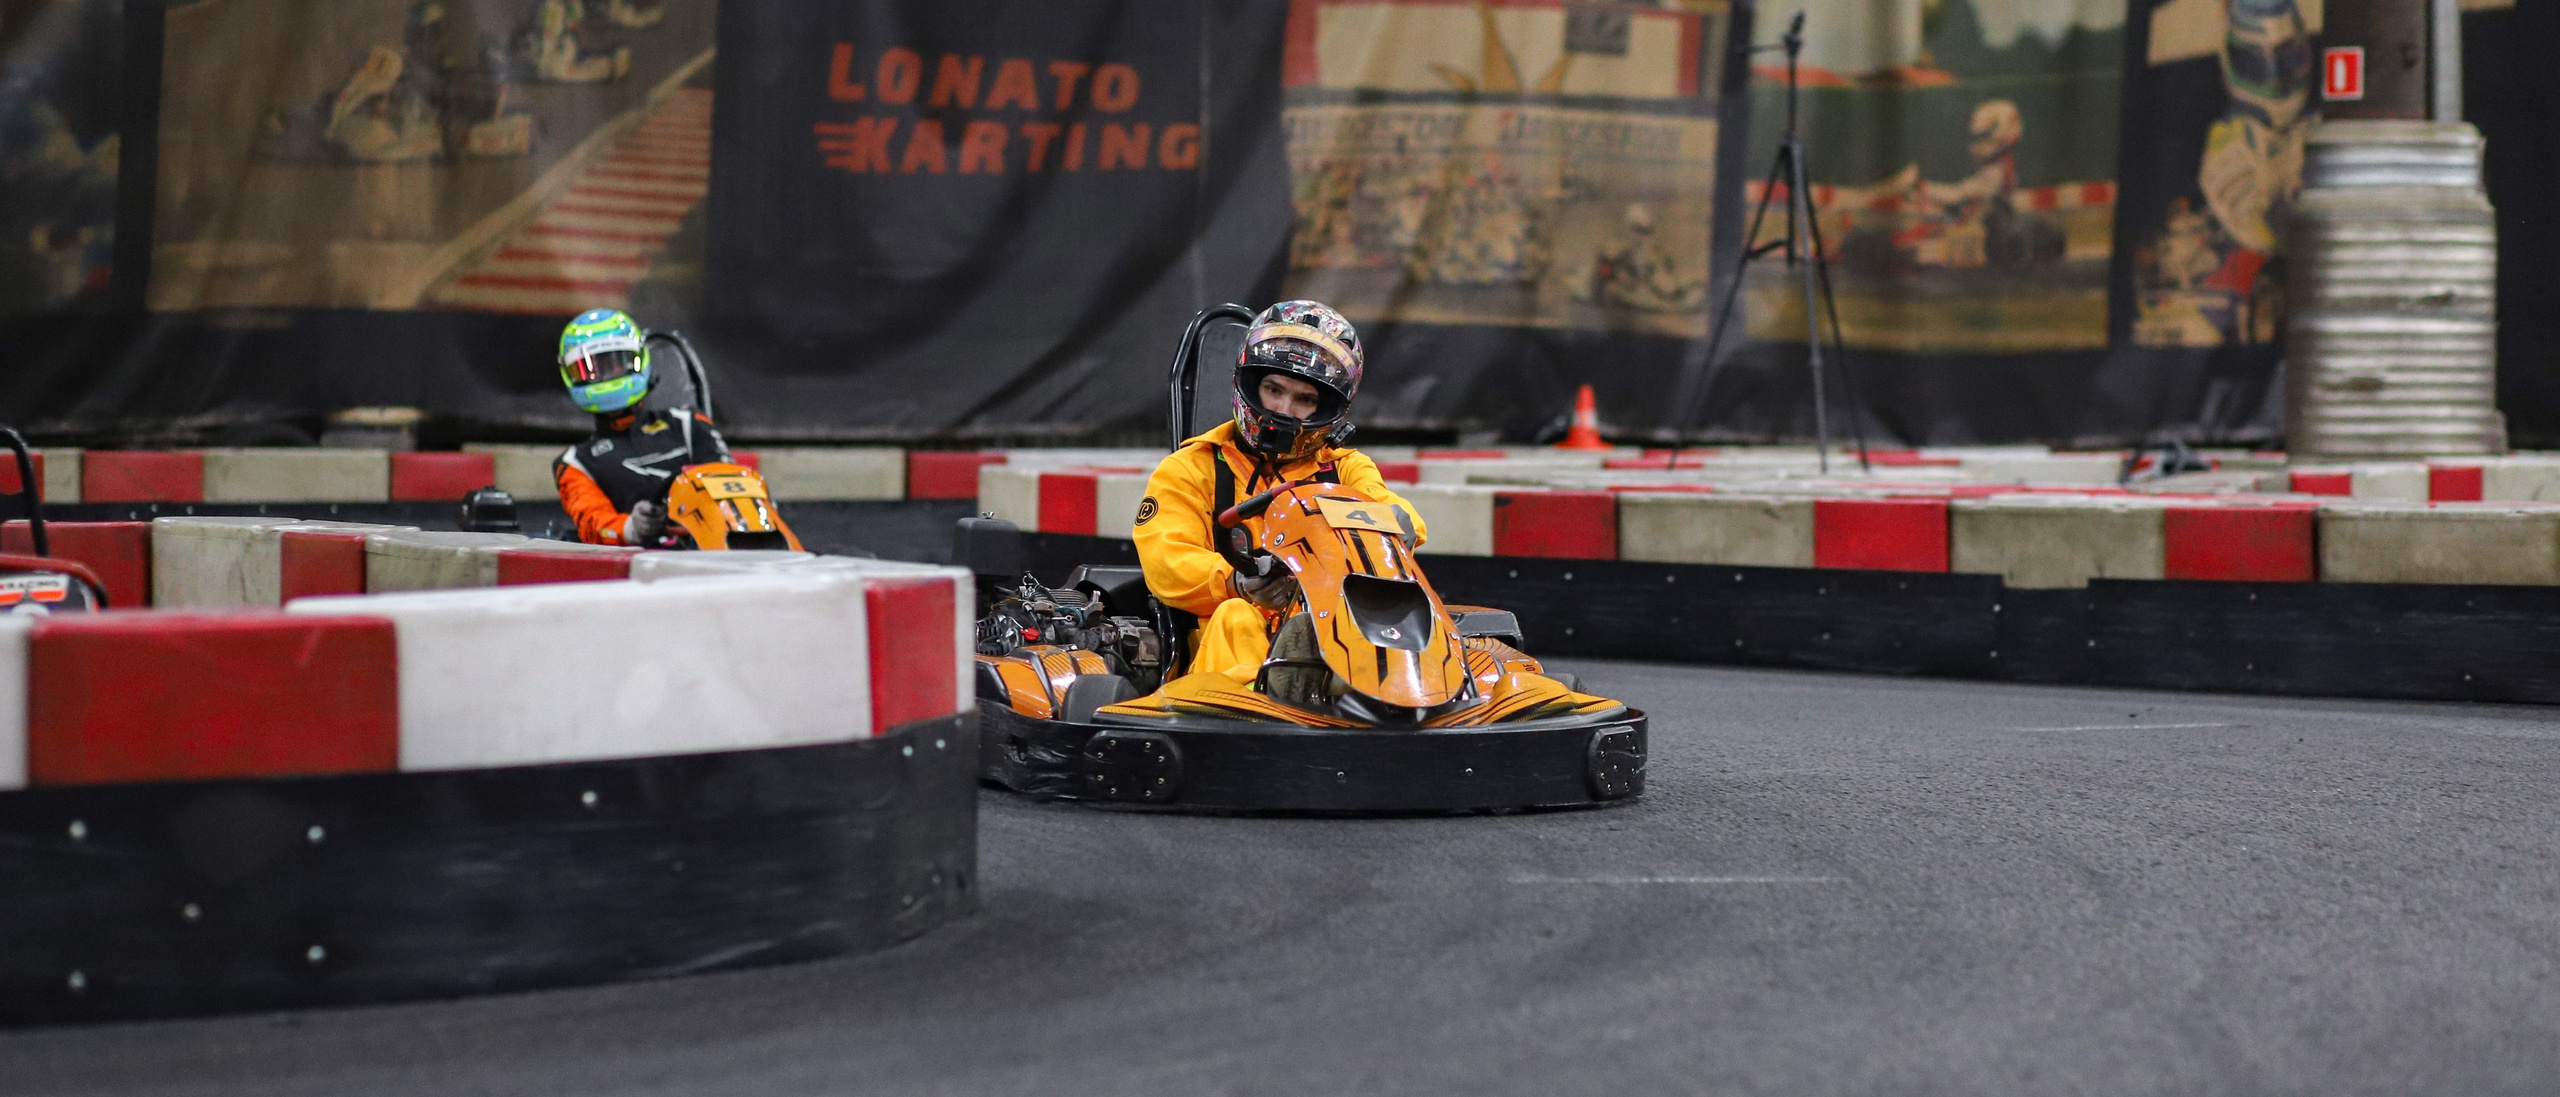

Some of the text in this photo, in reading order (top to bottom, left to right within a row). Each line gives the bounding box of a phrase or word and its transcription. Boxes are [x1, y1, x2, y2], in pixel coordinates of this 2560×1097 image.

[827, 42, 1140, 112] LONATO
[832, 116, 1200, 174] KARTING
[723, 482, 745, 493] 8
[1346, 510, 1377, 525] 4
